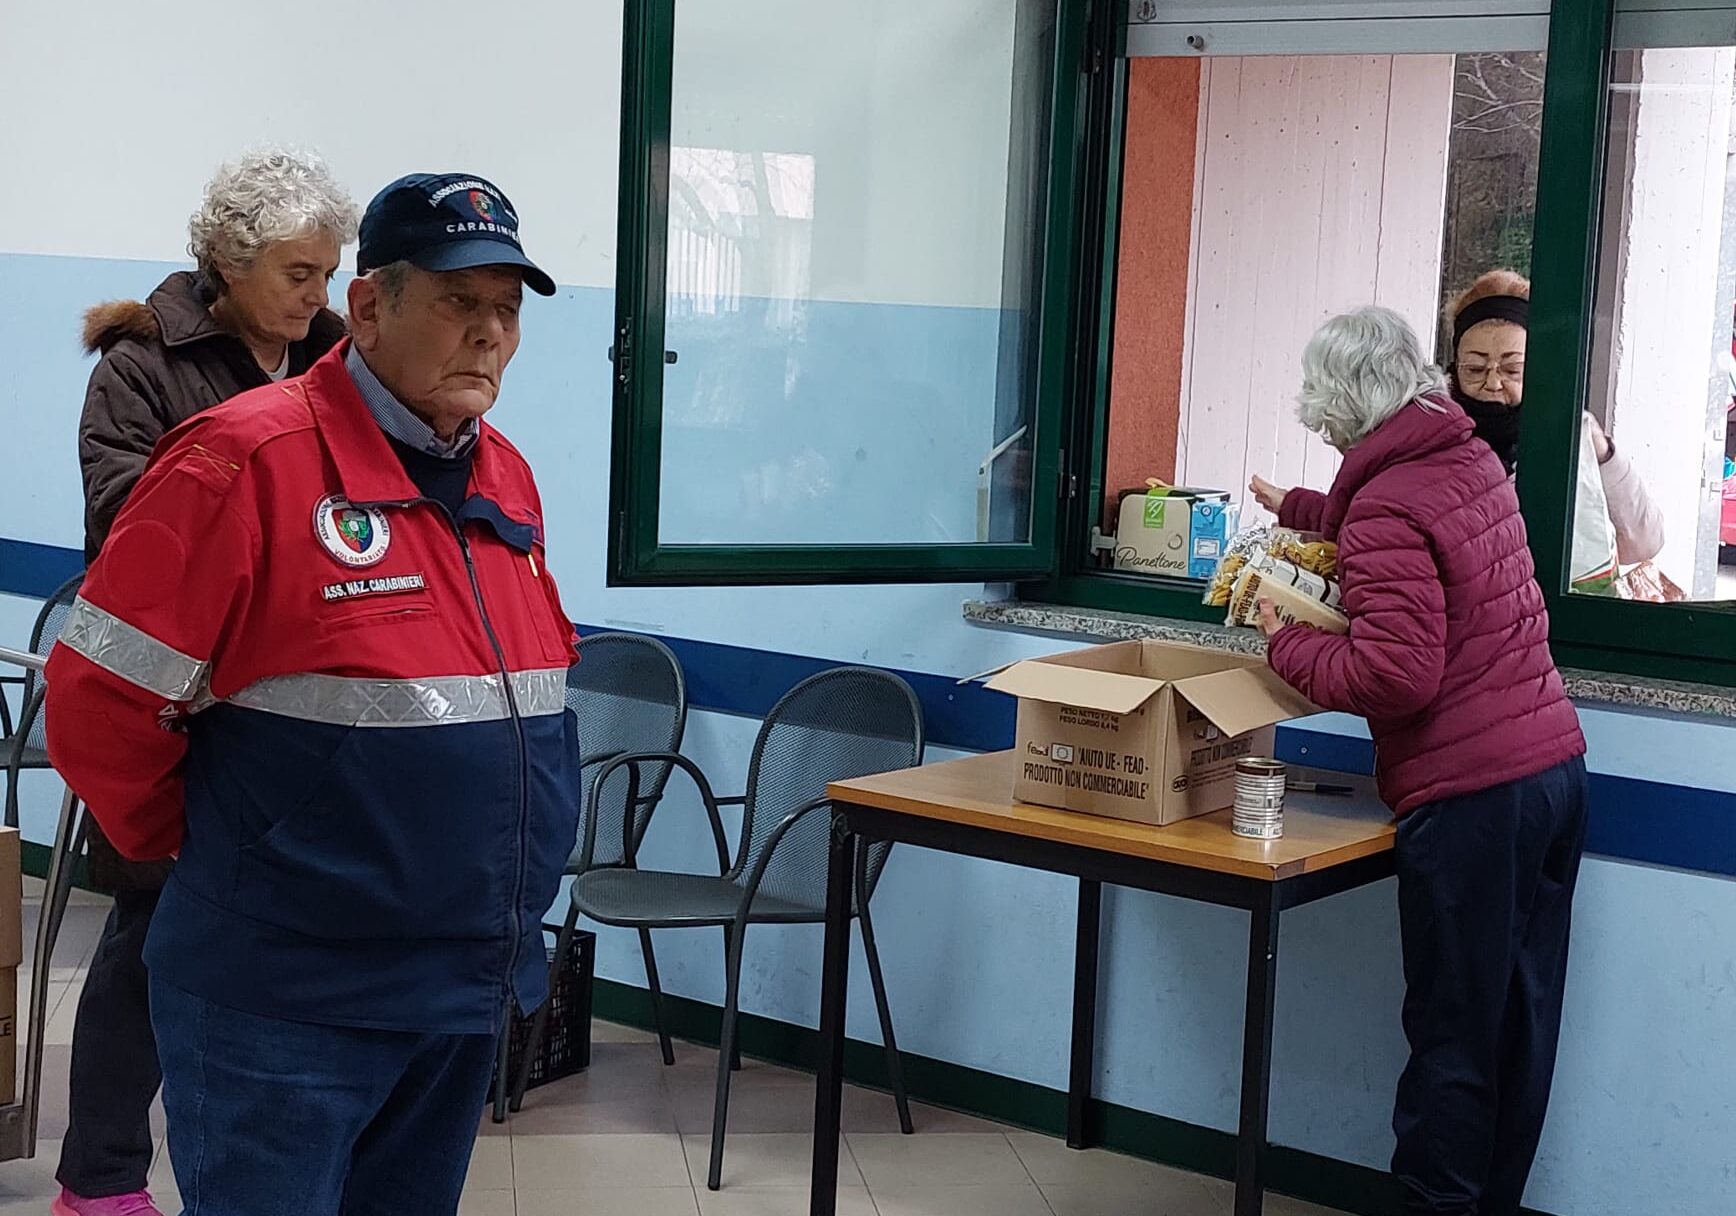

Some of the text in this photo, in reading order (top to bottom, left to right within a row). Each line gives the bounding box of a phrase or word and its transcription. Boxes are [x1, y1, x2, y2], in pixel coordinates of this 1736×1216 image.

[1117, 546, 1186, 570] Panettone
[324, 584, 347, 600] ASS.
[369, 574, 424, 591] CARABINIERI
[1059, 715, 1077, 725] PESO
[1078, 718, 1100, 729] LORDO
[1061, 706, 1077, 716] PESO
[1079, 709, 1100, 719] NETTO
[1024, 762, 1063, 786] PRODOTTO
[1065, 769, 1081, 789] NON
